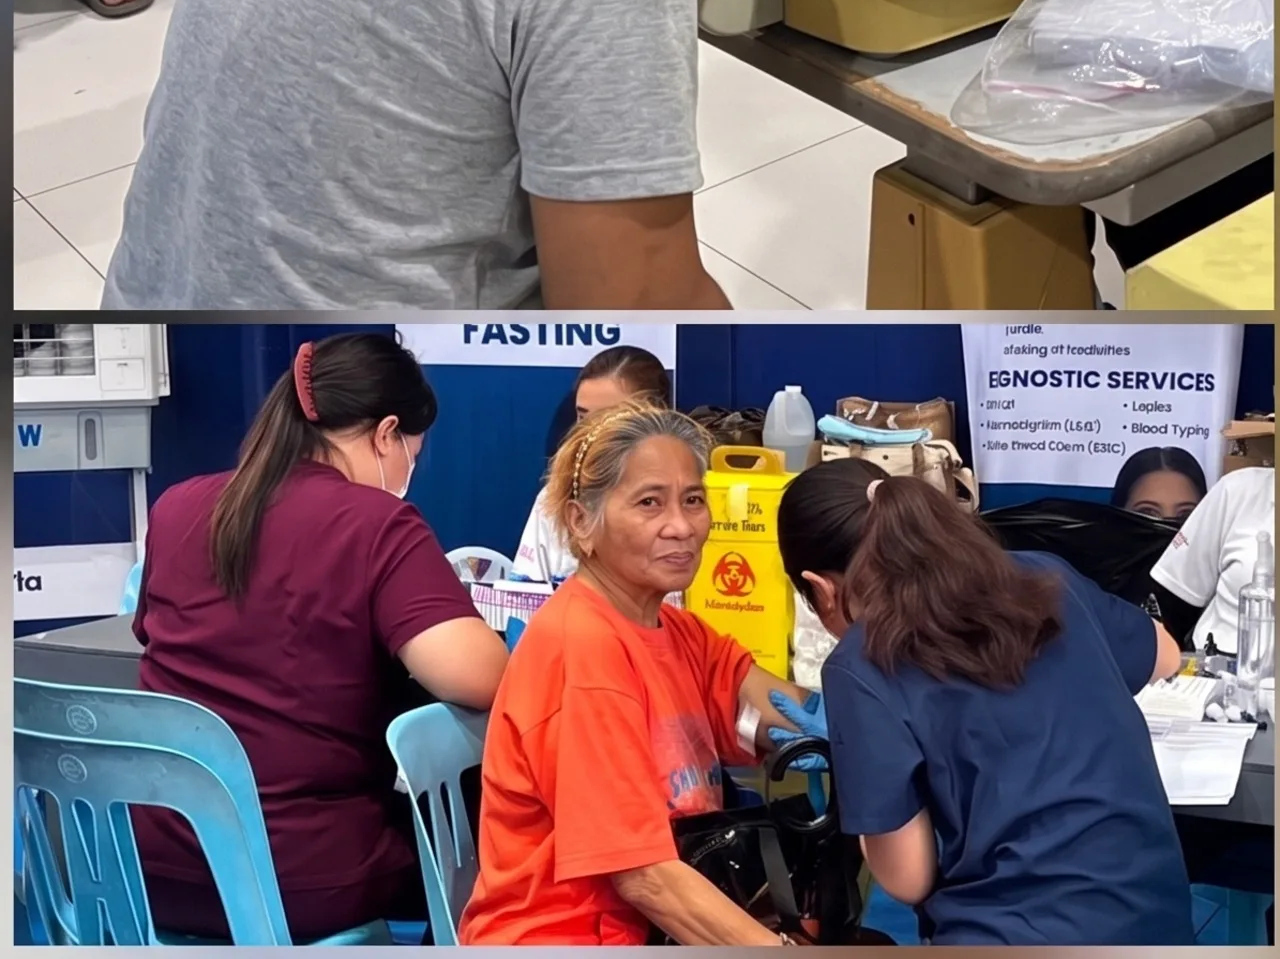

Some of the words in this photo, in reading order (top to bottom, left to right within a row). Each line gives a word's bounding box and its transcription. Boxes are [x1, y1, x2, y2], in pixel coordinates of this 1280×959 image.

[463, 324, 621, 346] FASTING
[1107, 371, 1215, 391] SERVICES
[1131, 423, 1168, 434] Blood
[1172, 424, 1210, 440] Typing
[14, 570, 42, 592] ta
